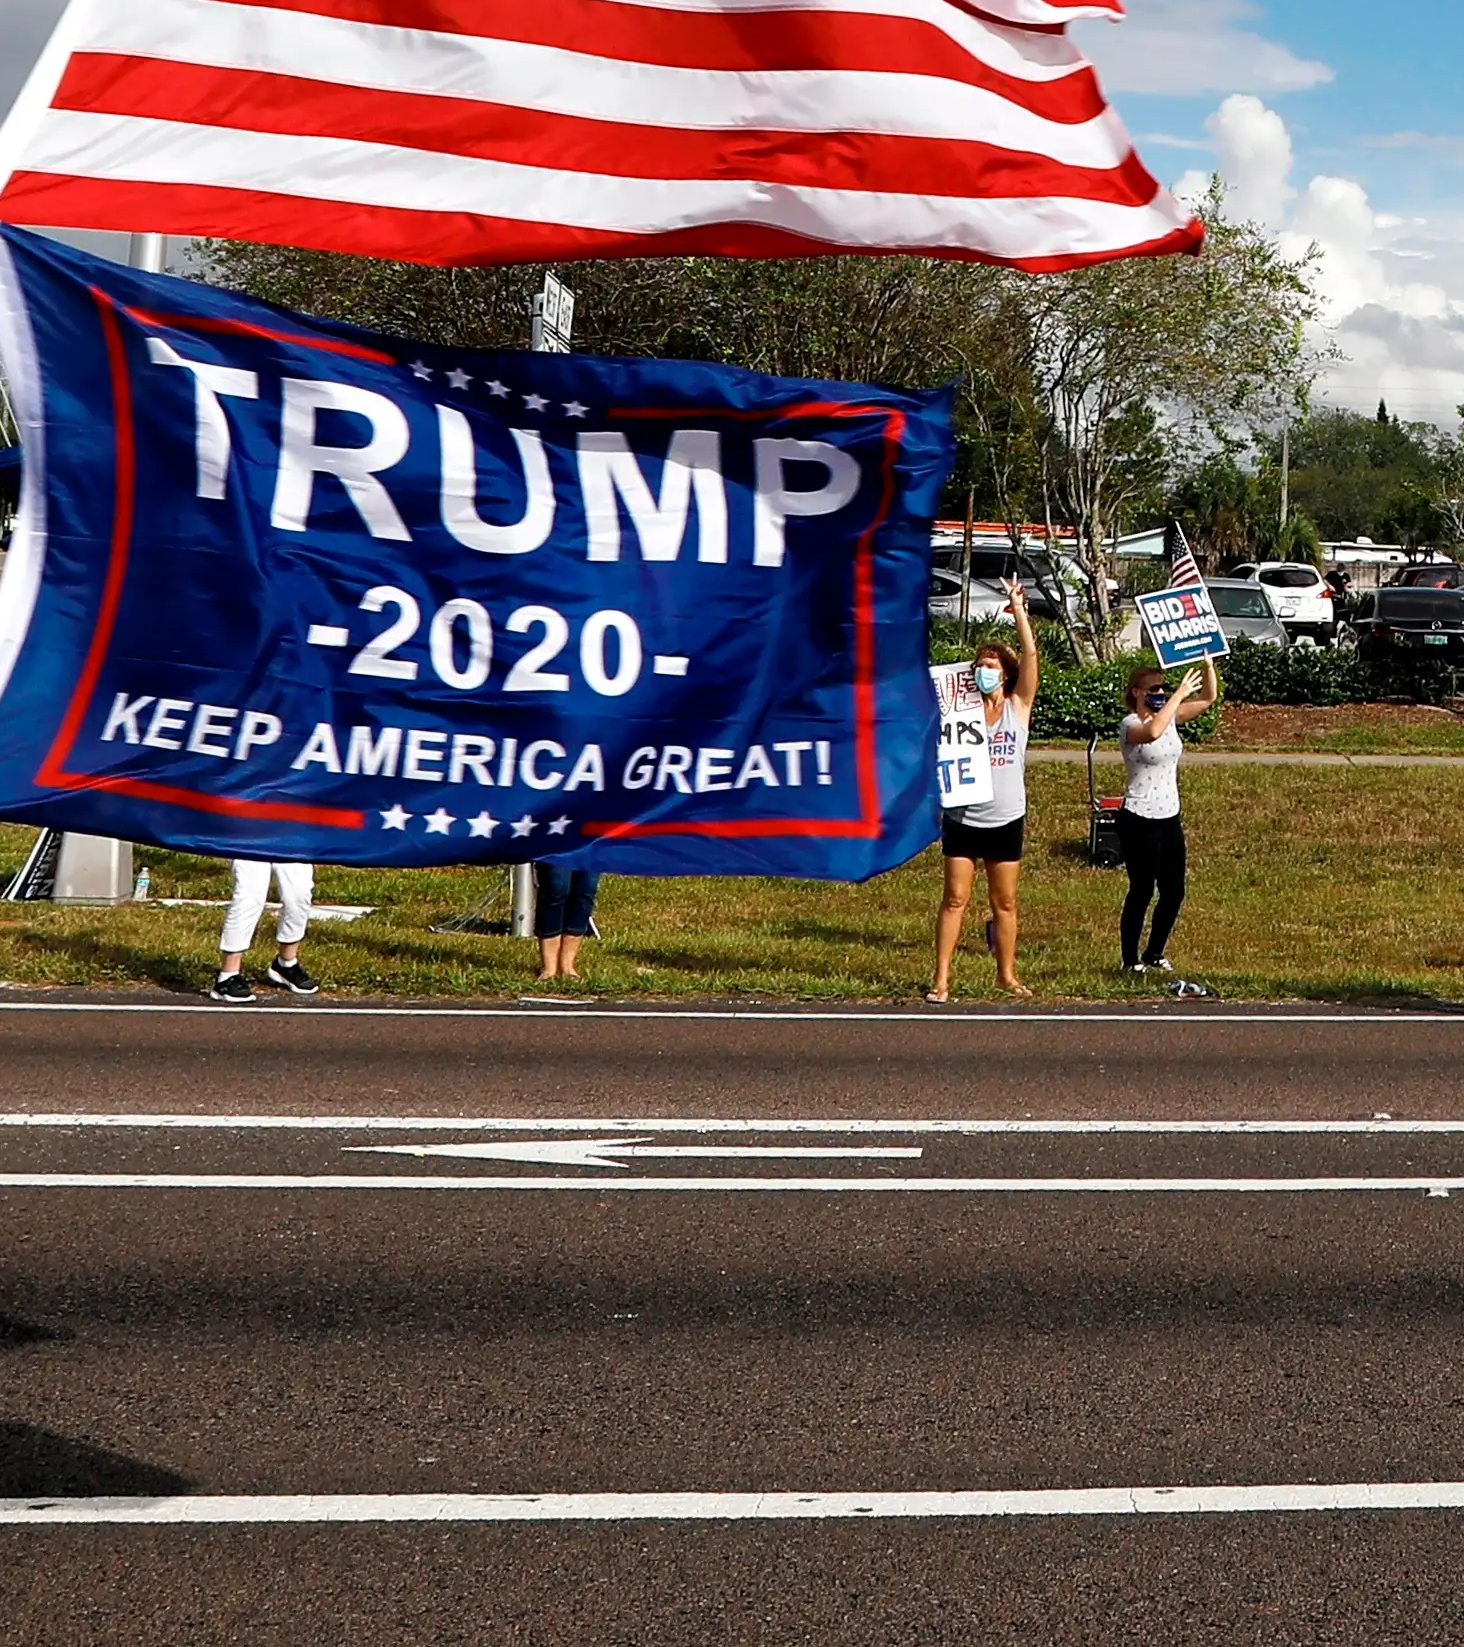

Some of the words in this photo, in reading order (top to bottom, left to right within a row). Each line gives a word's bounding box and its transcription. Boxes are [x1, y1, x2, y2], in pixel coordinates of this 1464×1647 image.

[145, 337, 862, 567] TRUMP
[1143, 591, 1212, 625] BIDEN
[1152, 614, 1219, 645] HARRIS
[100, 692, 283, 761] KEEP
[291, 723, 606, 792] AMERICA
[622, 740, 833, 793] GREAT!
